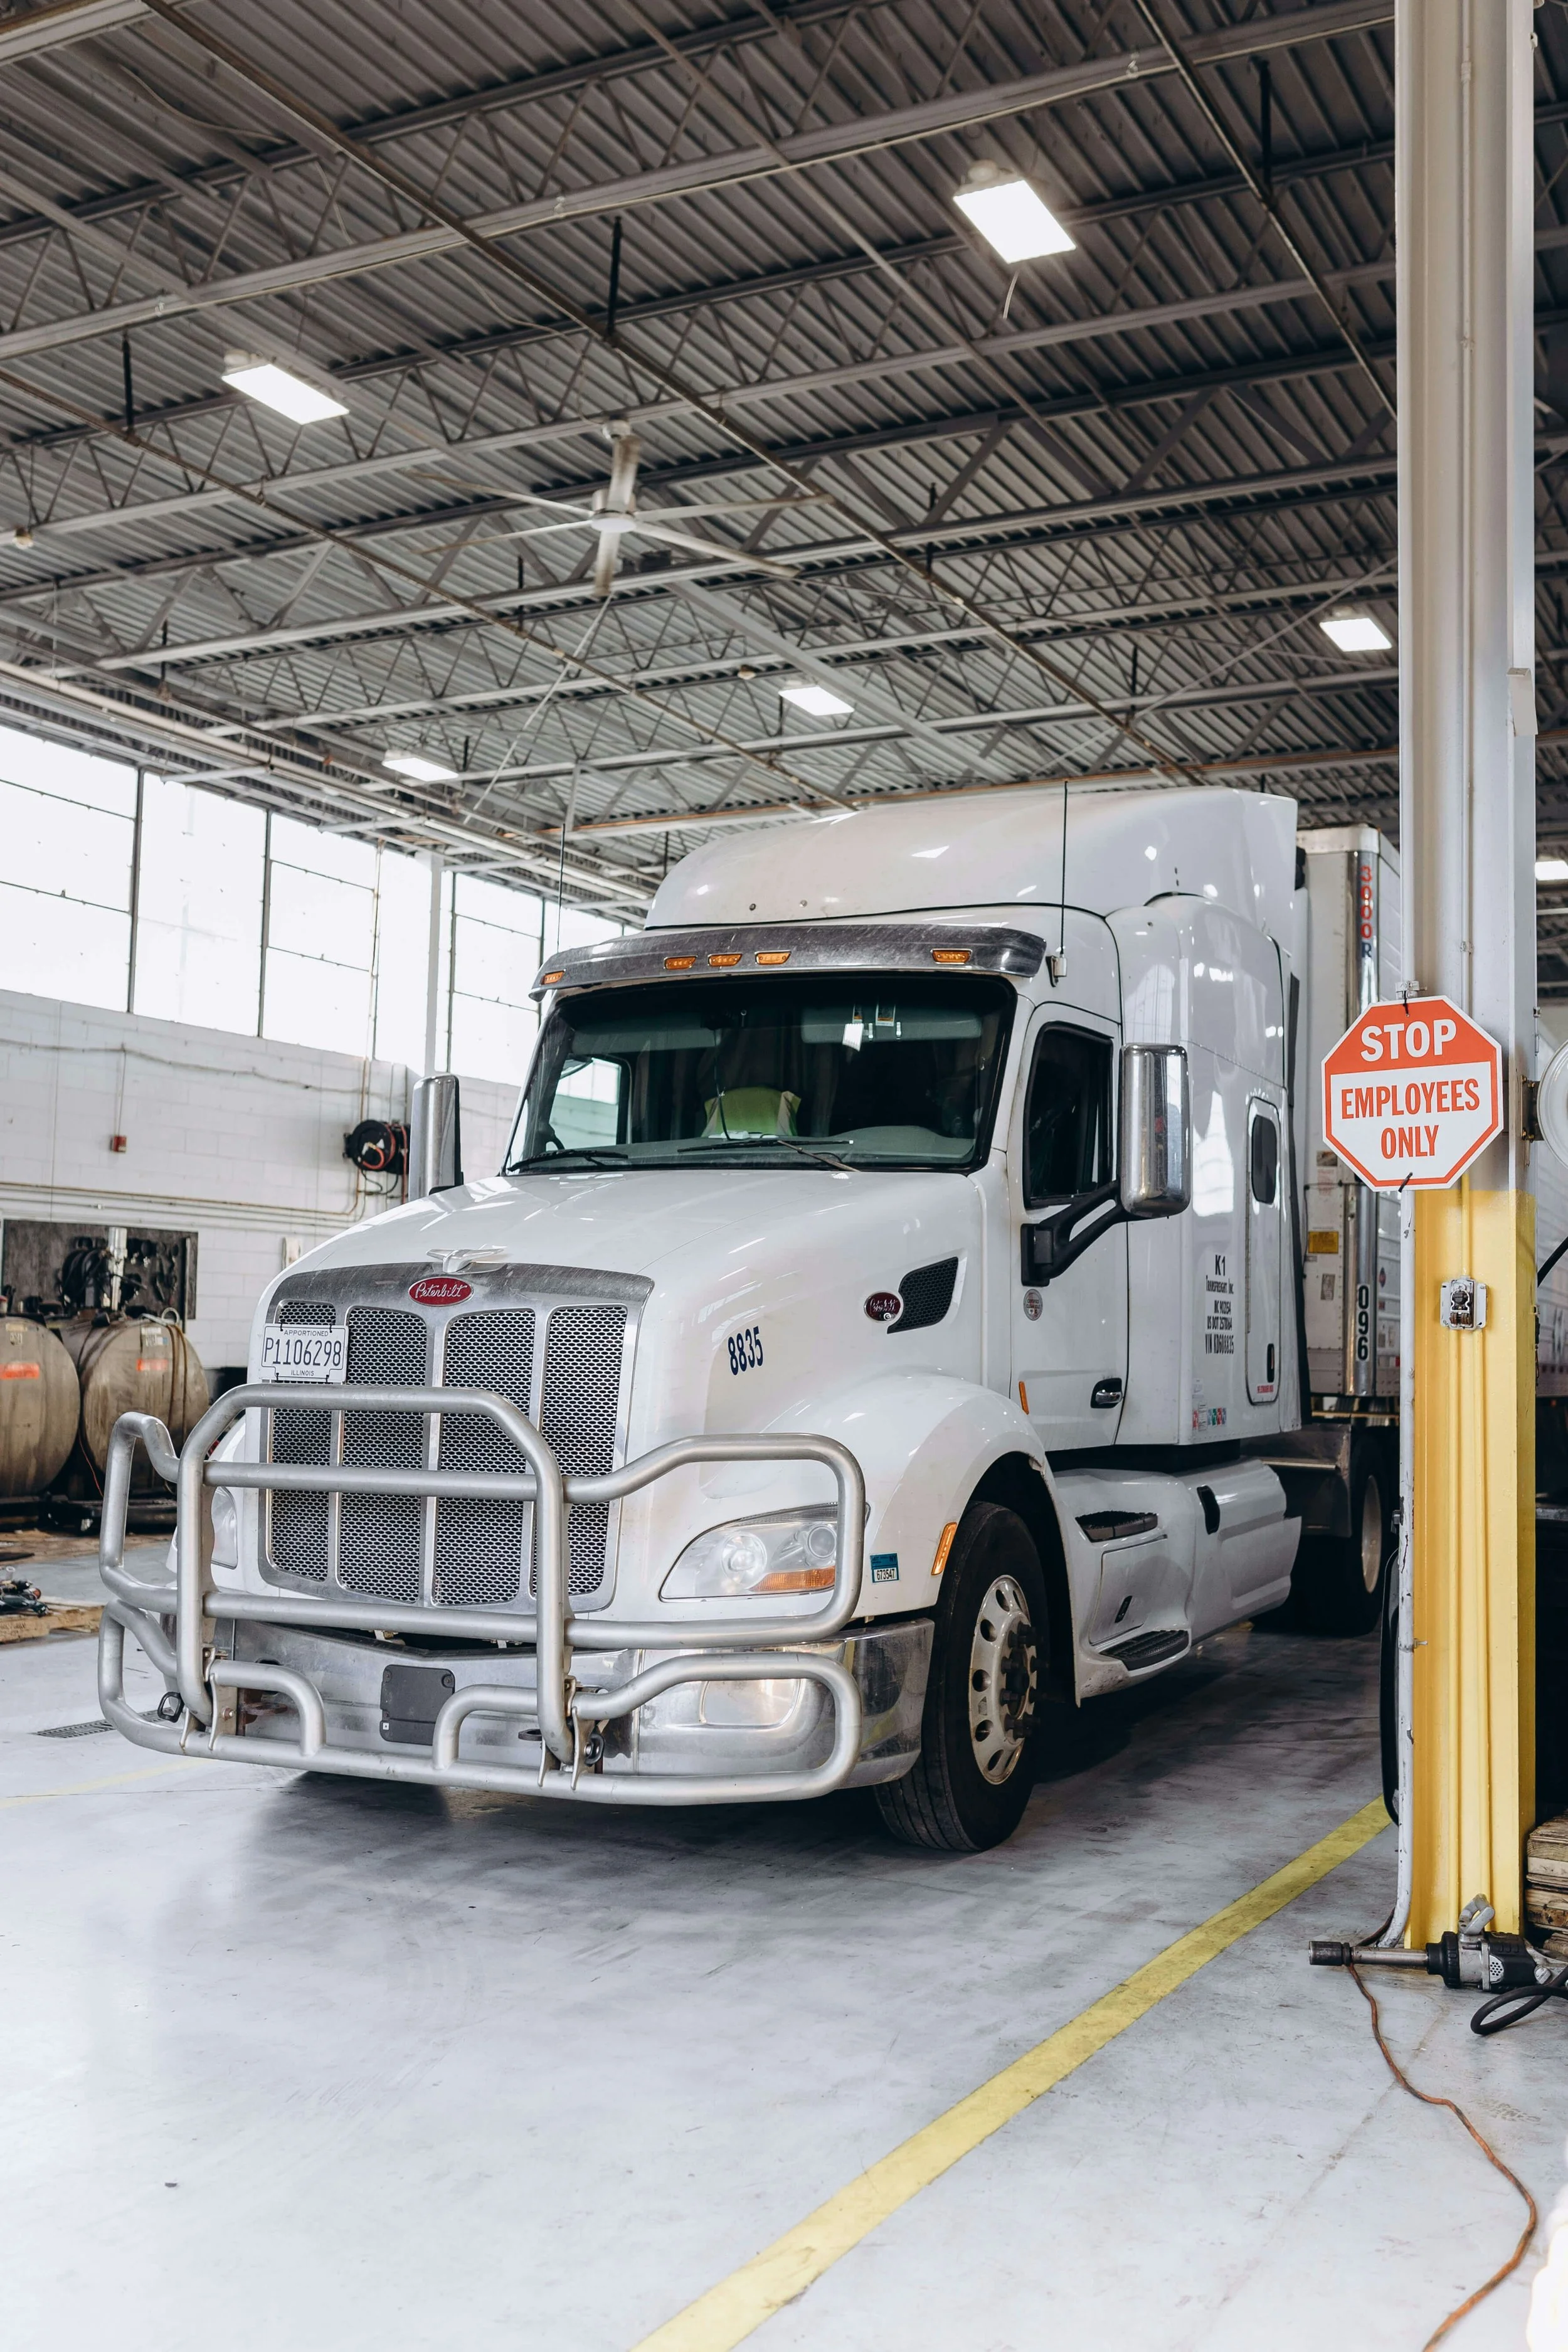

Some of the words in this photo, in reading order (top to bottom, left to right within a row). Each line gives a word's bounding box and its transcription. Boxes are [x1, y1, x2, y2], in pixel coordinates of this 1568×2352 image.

[1360, 1019, 1456, 1062] STOP
[1341, 1078, 1480, 1120] EMPLOYEES
[1380, 1125, 1439, 1159] ONLY
[1215, 1254, 1226, 1276] K1
[415, 1281, 468, 1298] Peterbilt
[1358, 1285, 1369, 1360] 096
[264, 1337, 342, 1366] P1106298
[728, 1326, 763, 1375] 8835
[876, 1568, 895, 1581] 673547
